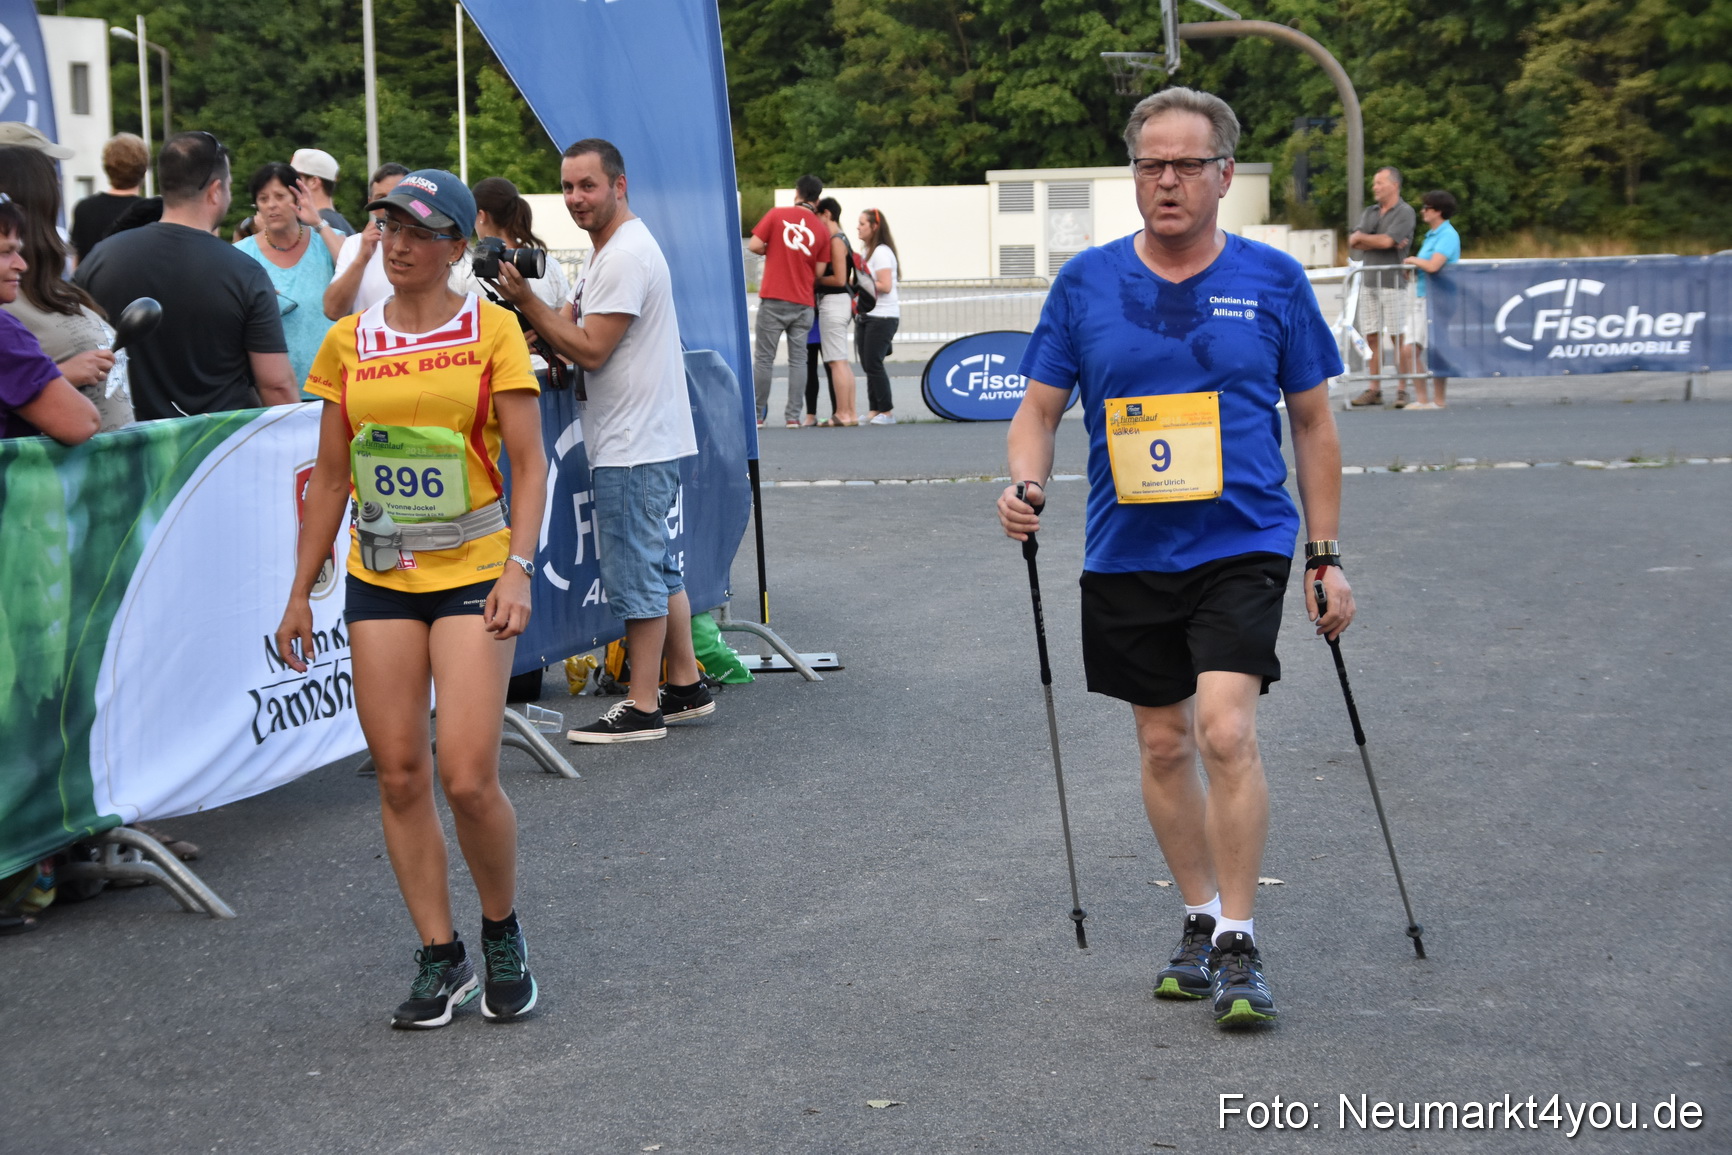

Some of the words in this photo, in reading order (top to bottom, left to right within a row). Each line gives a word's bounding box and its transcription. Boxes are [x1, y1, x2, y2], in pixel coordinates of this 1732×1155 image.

[1209, 296, 1241, 304] Christian
[1242, 298, 1258, 306] Lenz
[1212, 308, 1243, 317] Allianz
[1532, 305, 1706, 341] Fischer
[1547, 340, 1692, 359] AUTOMOBILE
[355, 360, 411, 382] MAX
[418, 350, 482, 373] BÖGL
[1149, 438, 1172, 473] 9
[374, 464, 444, 498] 896
[1141, 480, 1163, 488] Rainer
[1163, 478, 1186, 486] Ulrich
[386, 502, 412, 511] Yvonne
